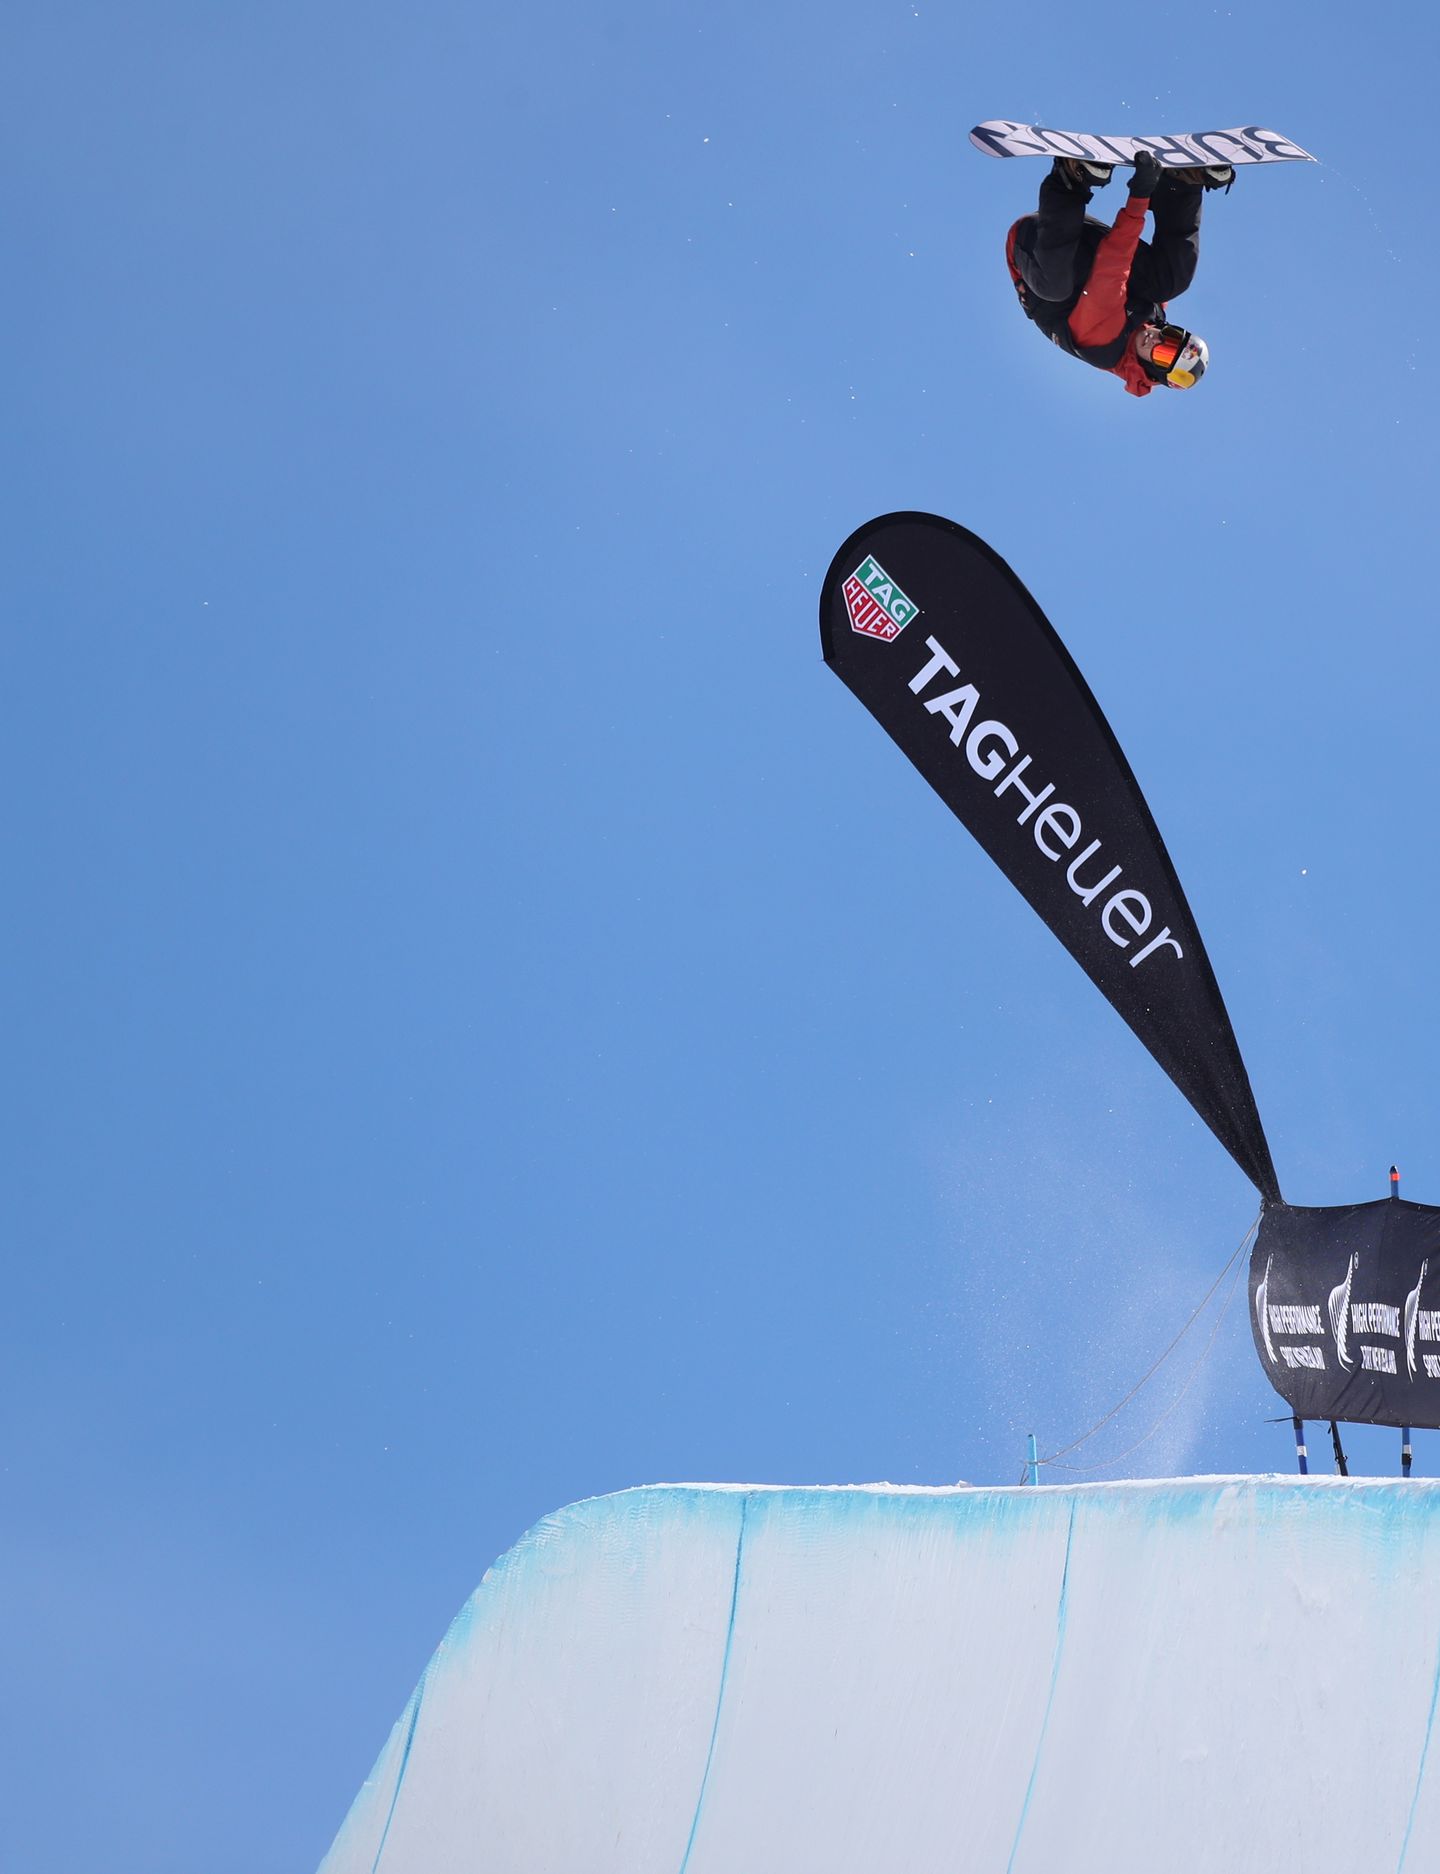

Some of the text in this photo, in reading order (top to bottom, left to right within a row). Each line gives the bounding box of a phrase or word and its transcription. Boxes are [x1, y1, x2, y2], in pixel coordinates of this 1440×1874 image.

[970, 122, 1305, 166] BURTON
[847, 580, 897, 637] HEUER
[864, 563, 911, 622] TAG
